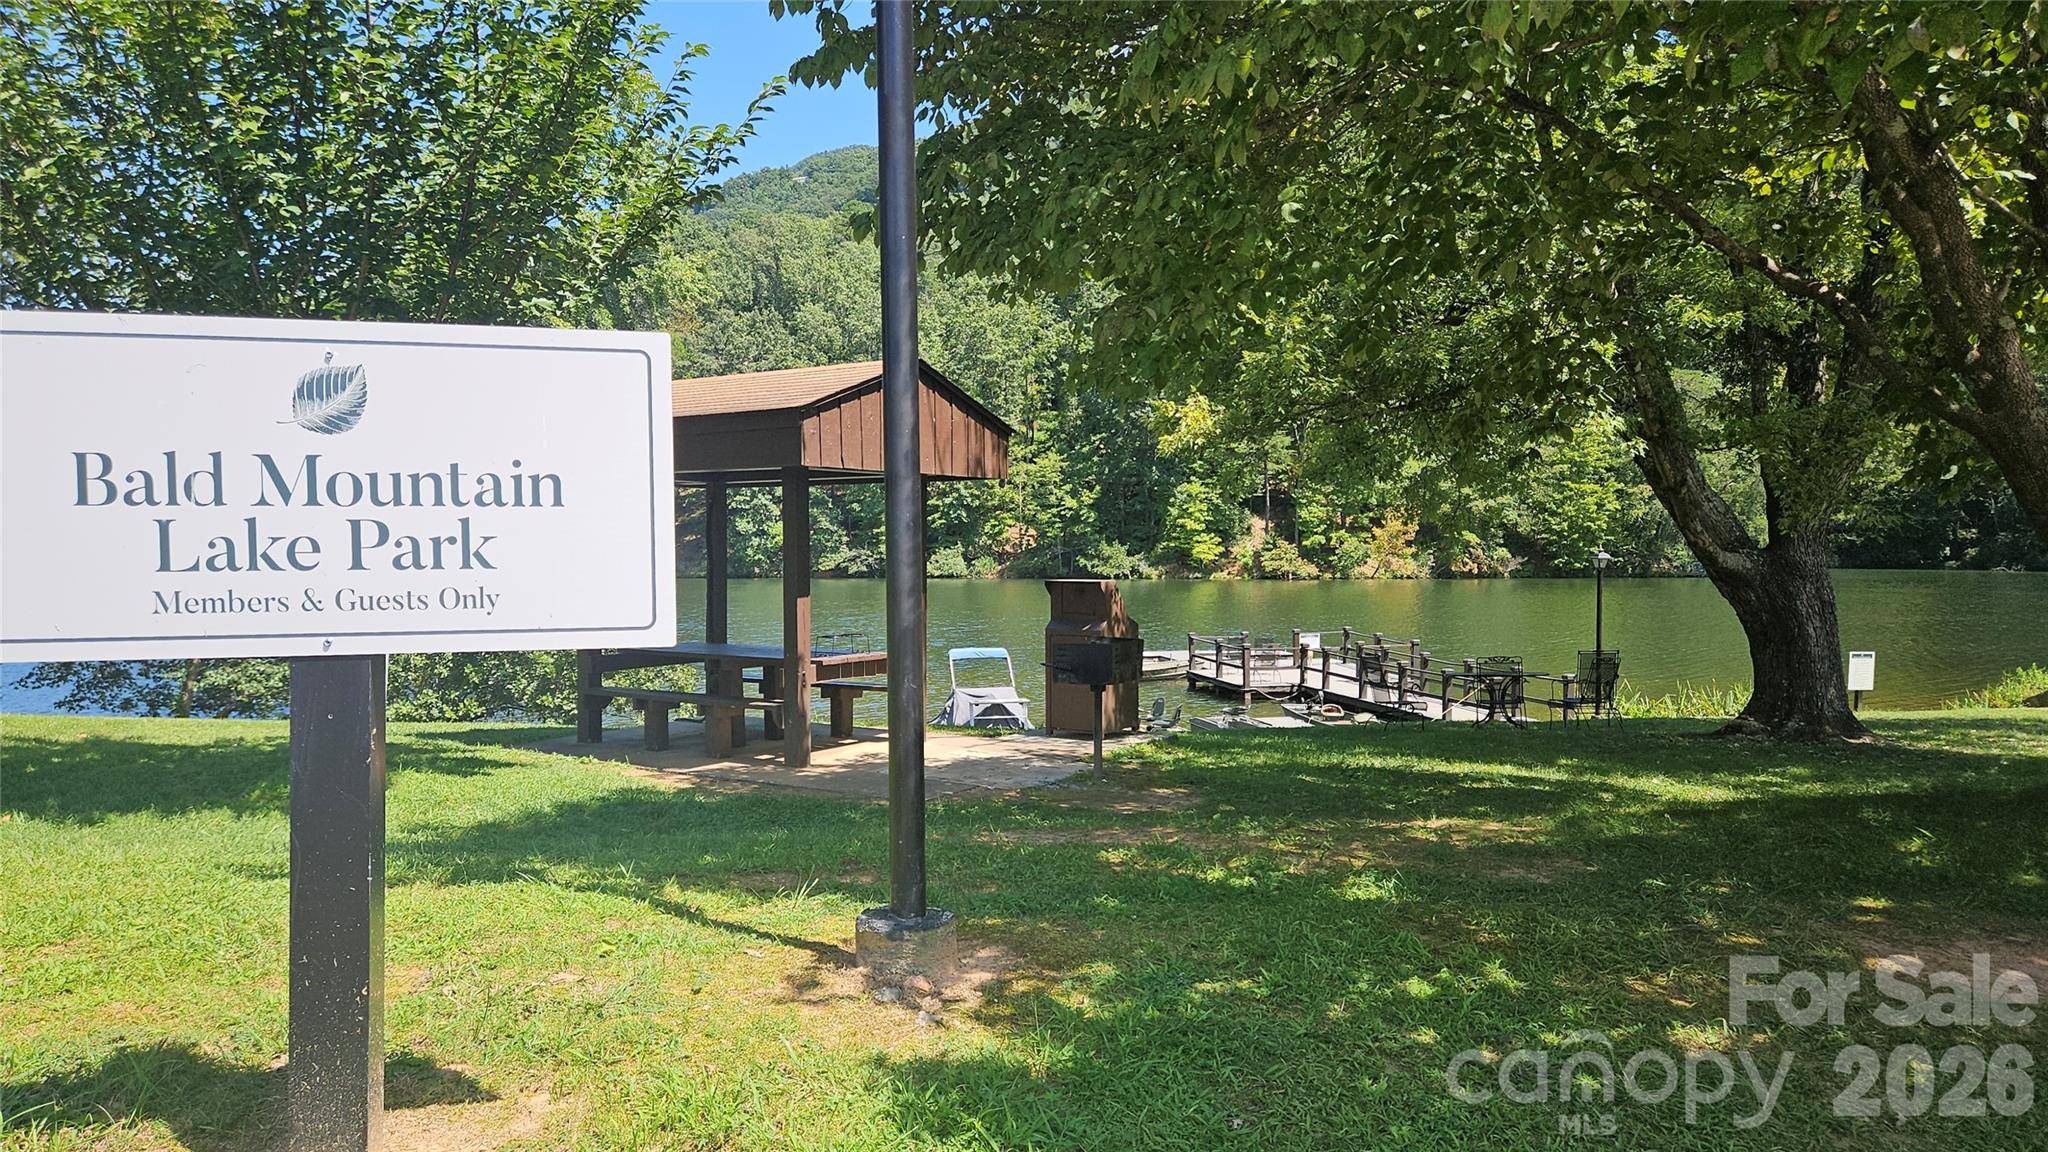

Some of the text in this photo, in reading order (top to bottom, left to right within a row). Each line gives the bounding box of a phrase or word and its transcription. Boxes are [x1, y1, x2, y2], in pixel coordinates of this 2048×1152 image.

[72, 450, 564, 508] Bald Mountain
[153, 516, 497, 573] Lake Park
[152, 586, 500, 615] Members & Guests Only
